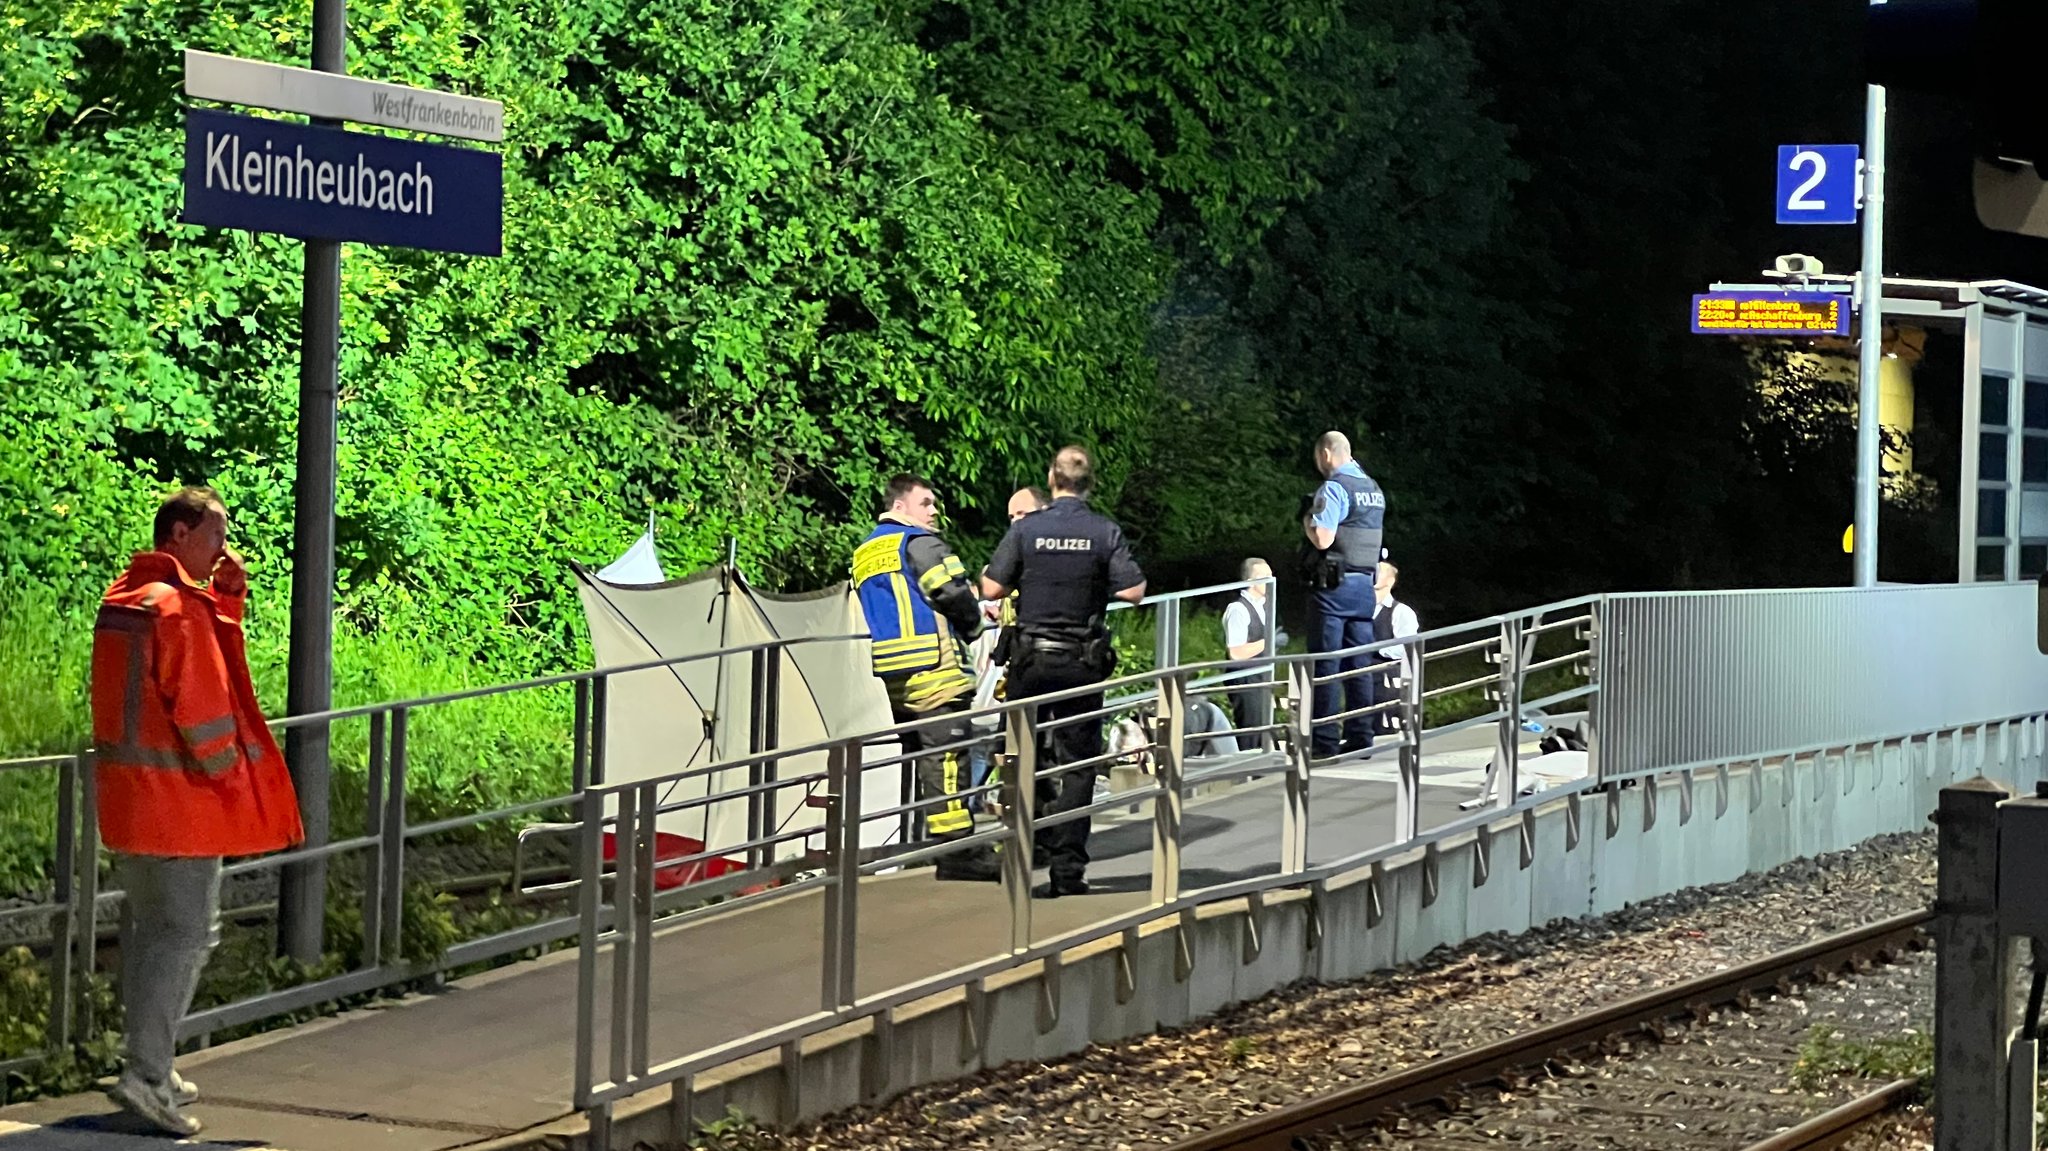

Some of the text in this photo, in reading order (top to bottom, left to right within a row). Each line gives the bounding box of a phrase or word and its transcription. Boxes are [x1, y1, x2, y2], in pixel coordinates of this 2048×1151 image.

[373, 91, 495, 132] Westfrankenbahn
[206, 131, 433, 215] Kleinheubach
[1787, 150, 1827, 210] 2
[1829, 300, 1838, 311] 2
[1829, 311, 1838, 321] 2
[1035, 537, 1091, 551] POLIZEI
